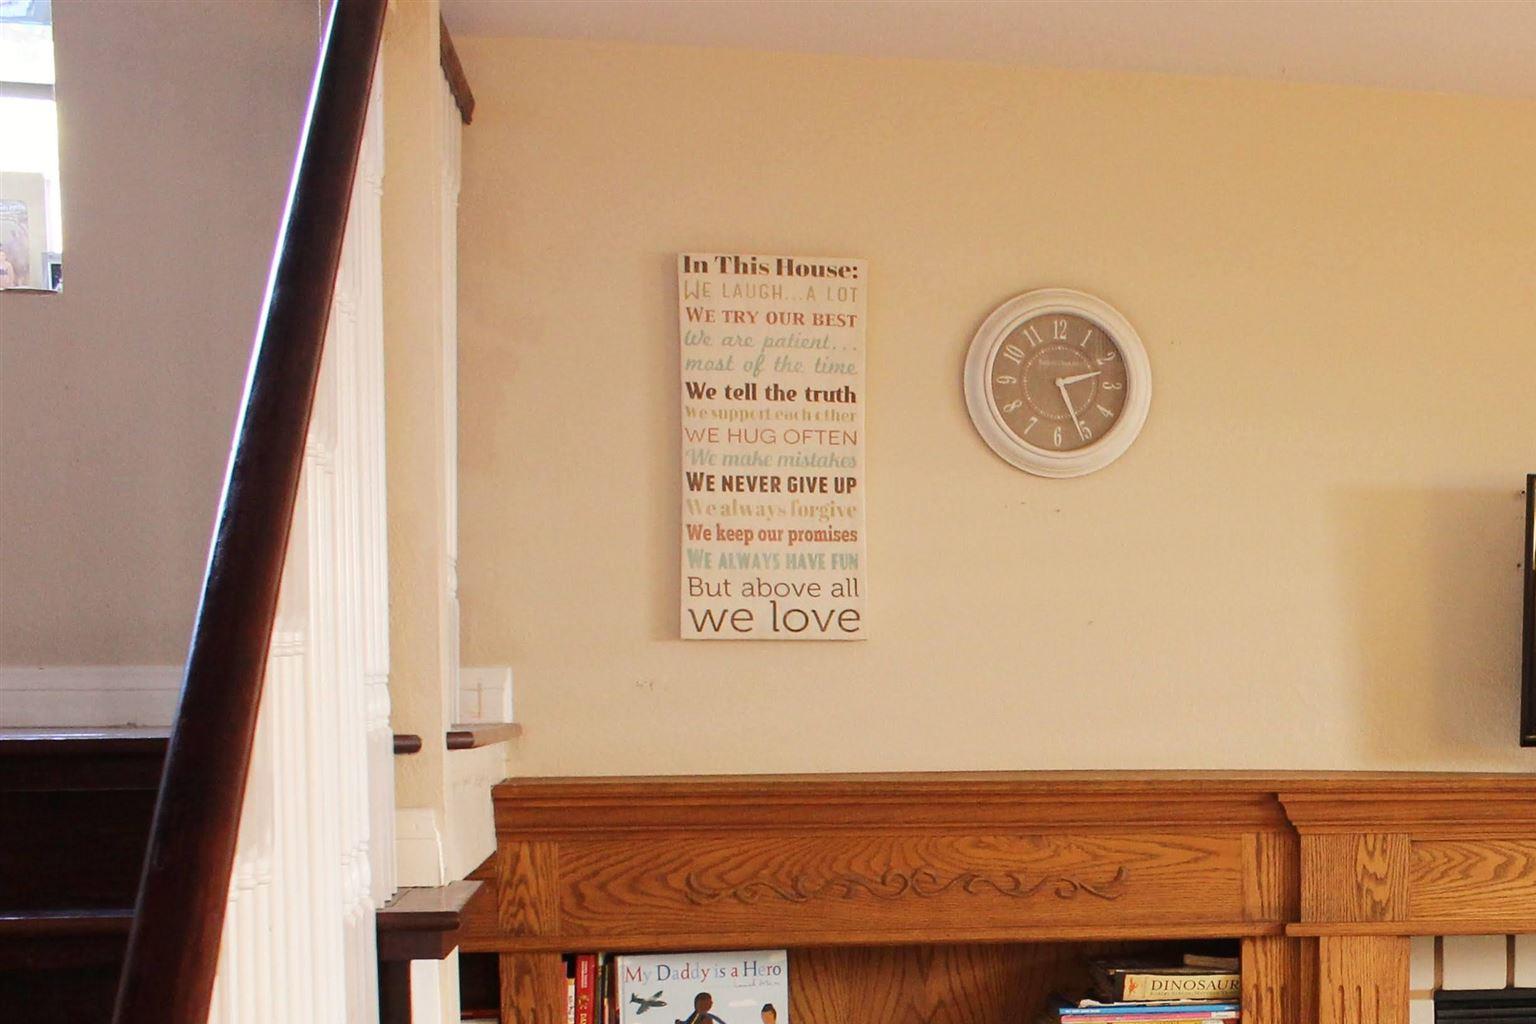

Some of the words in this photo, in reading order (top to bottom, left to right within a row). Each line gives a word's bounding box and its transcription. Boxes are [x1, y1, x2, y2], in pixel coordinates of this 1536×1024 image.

[683, 255, 708, 274] In
[714, 256, 770, 275] This
[776, 258, 859, 279] House:
[684, 280, 712, 301] WE
[827, 287, 858, 303] LOT
[686, 306, 716, 323] WE
[722, 310, 759, 325] TRY
[766, 311, 805, 326] OUR
[813, 313, 858, 328] BEST
[685, 330, 713, 346] We
[721, 336, 755, 348] are
[1023, 325, 1043, 347] 11
[1053, 319, 1067, 340] 12
[1080, 329, 1093, 348] 1
[1003, 345, 1025, 365] 10
[1096, 351, 1117, 366] 2
[685, 355, 735, 371] most
[744, 354, 765, 378] of
[775, 356, 804, 373] the
[815, 357, 858, 375] time
[996, 375, 1017, 385] 9
[1102, 381, 1122, 390] 3
[686, 382, 717, 399] We
[725, 383, 757, 401] tell
[765, 383, 798, 402] the
[805, 386, 857, 404] truth
[685, 406, 708, 419] We
[711, 407, 772, 423] support
[1003, 400, 1023, 413] 8
[1096, 404, 1115, 418] 4
[1024, 416, 1039, 435] 7
[1078, 420, 1092, 440] 5
[685, 427, 720, 443] WE
[728, 428, 777, 444] HUG
[783, 429, 858, 446] OFTEN
[1053, 426, 1062, 447] 6
[687, 448, 718, 467] We
[722, 451, 773, 468] make
[777, 451, 857, 469] mistakes
[686, 471, 716, 492] WE
[721, 475, 781, 493] NEVER
[787, 476, 829, 494] GIVE
[834, 477, 857, 494] UP
[687, 498, 716, 517] We
[721, 499, 786, 521] always
[789, 500, 857, 522] forgive
[686, 523, 712, 541] We
[716, 523, 754, 546] keep
[758, 528, 784, 542] our
[788, 525, 858, 546] promises
[687, 548, 713, 570] WE
[718, 551, 780, 570] ALWAYS
[786, 552, 826, 570] HAVE
[831, 553, 859, 570] FUN
[688, 576, 731, 598] But
[741, 577, 822, 598] above
[831, 578, 859, 598] all
[688, 608, 754, 633] we
[769, 600, 861, 633] love
[625, 965, 650, 985] My
[657, 962, 710, 983] Daddy
[714, 962, 726, 977] is
[731, 967, 739, 977] a
[743, 960, 782, 977] Hero
